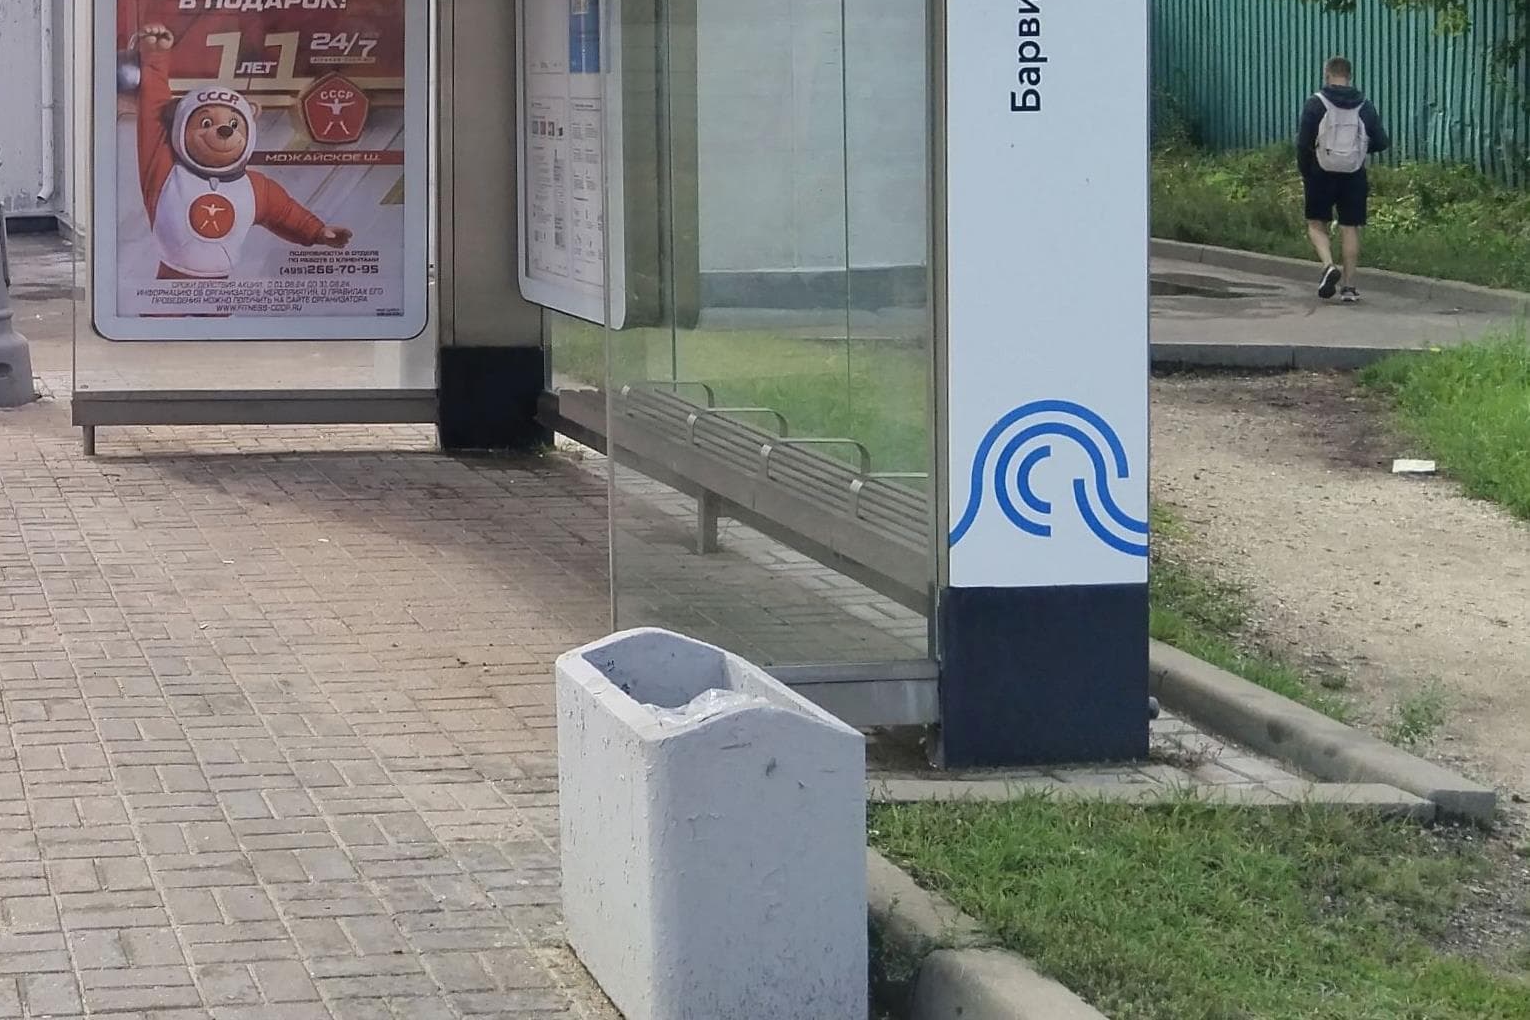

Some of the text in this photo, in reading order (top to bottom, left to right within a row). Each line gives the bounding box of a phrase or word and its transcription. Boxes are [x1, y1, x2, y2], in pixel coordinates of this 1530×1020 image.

[311, 32, 378, 59] 24/7
[236, 61, 277, 74] ЛЕТ
[197, 91, 239, 104] СССР
[320, 90, 353, 100] СССР
[265, 153, 361, 162] МОЖАЙСКОЕ
